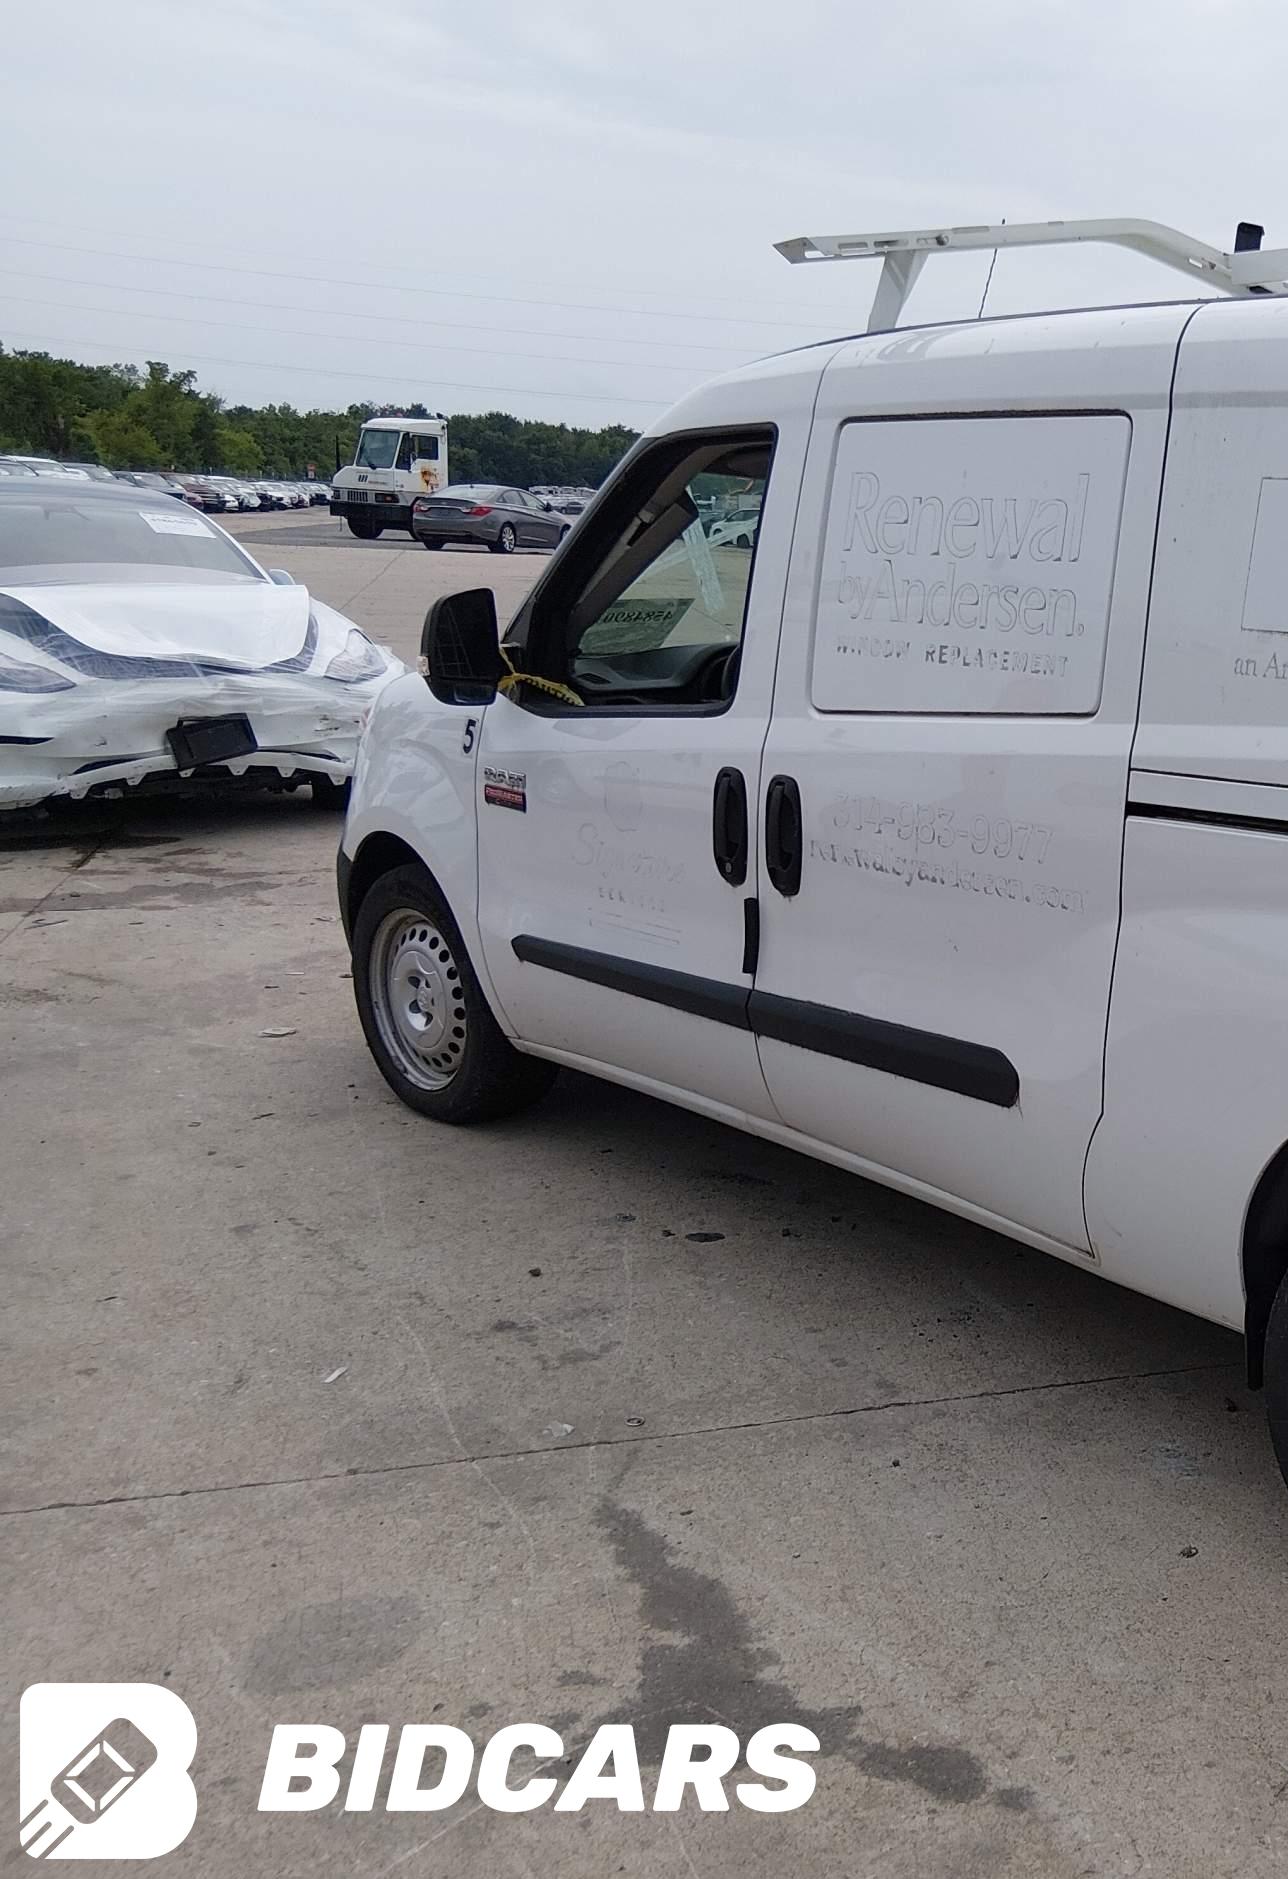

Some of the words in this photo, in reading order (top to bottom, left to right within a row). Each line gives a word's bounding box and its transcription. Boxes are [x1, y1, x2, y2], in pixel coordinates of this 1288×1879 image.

[840, 471, 1092, 563] Renewal
[1233, 656, 1258, 679] an
[463, 718, 477, 755] 5
